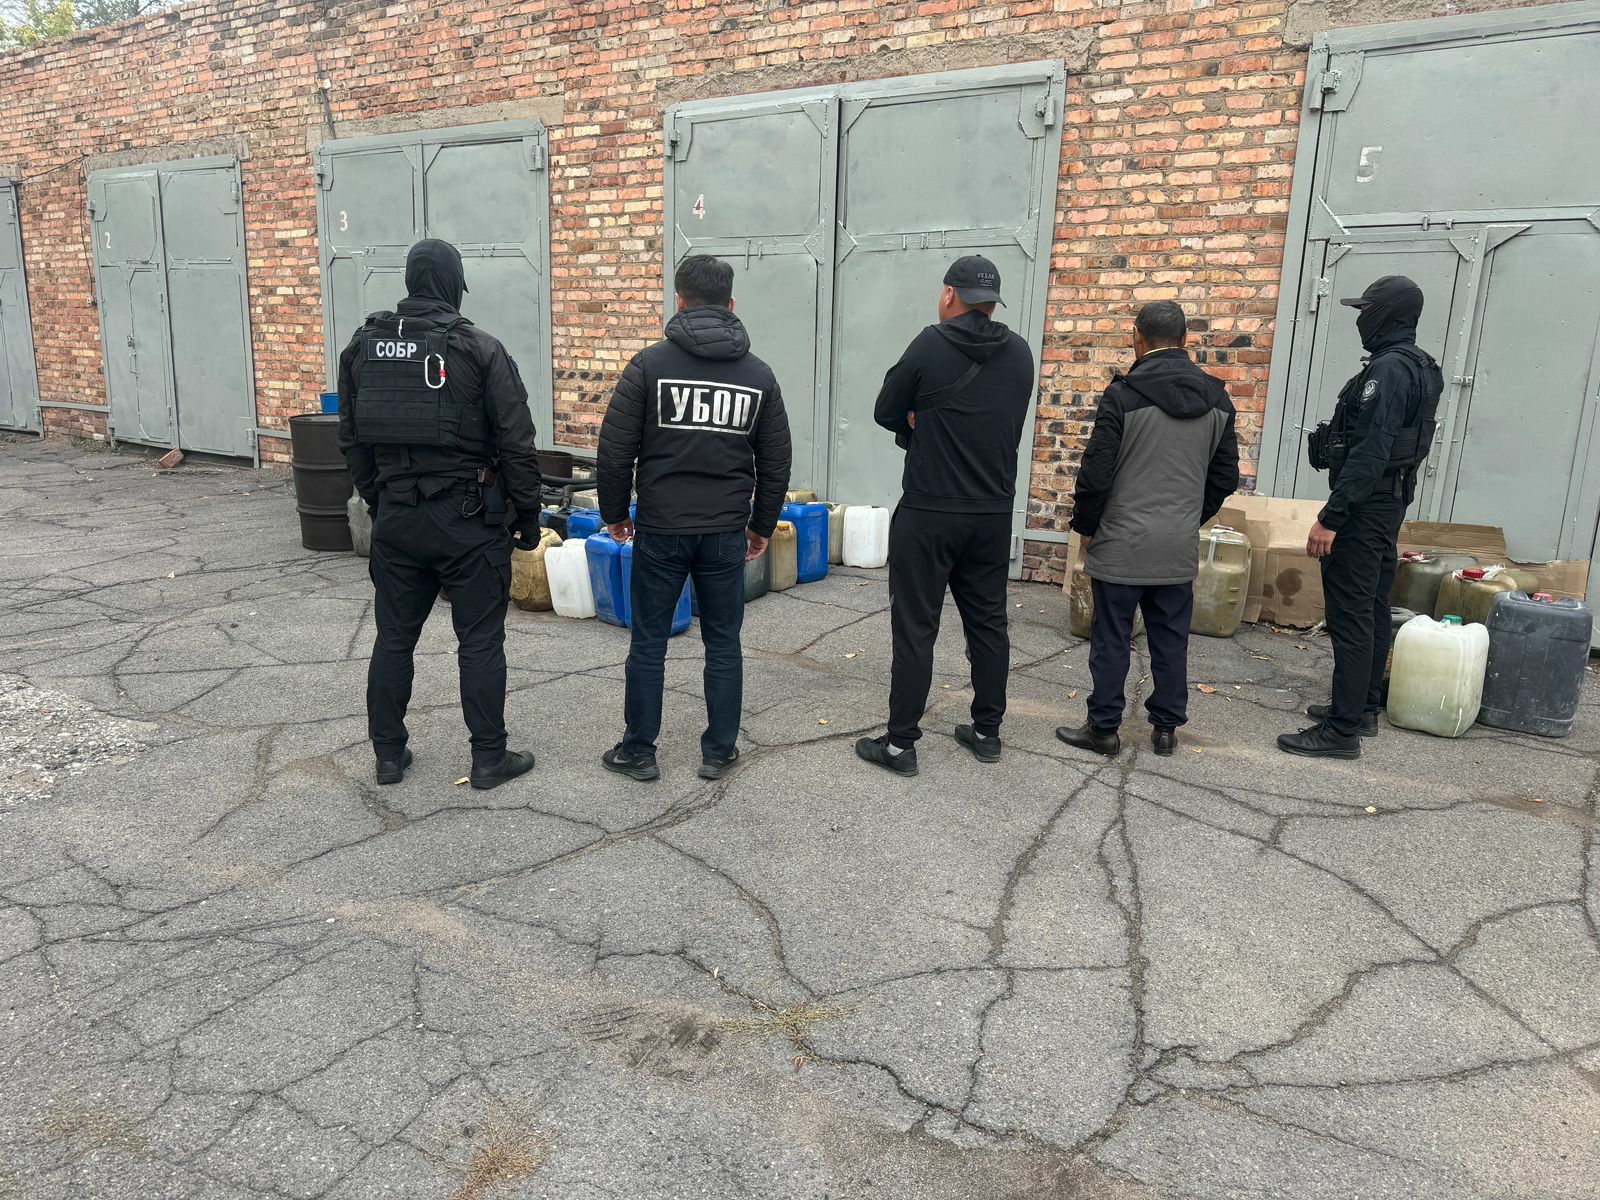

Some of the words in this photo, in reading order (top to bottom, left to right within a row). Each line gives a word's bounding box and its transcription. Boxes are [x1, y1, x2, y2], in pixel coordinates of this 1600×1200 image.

[1355, 146, 1383, 183] 5
[692, 193, 706, 220] 4
[339, 210, 348, 232] 3
[104, 231, 112, 249] 2
[375, 341, 418, 358] СОБР
[670, 386, 752, 428] УБОП
